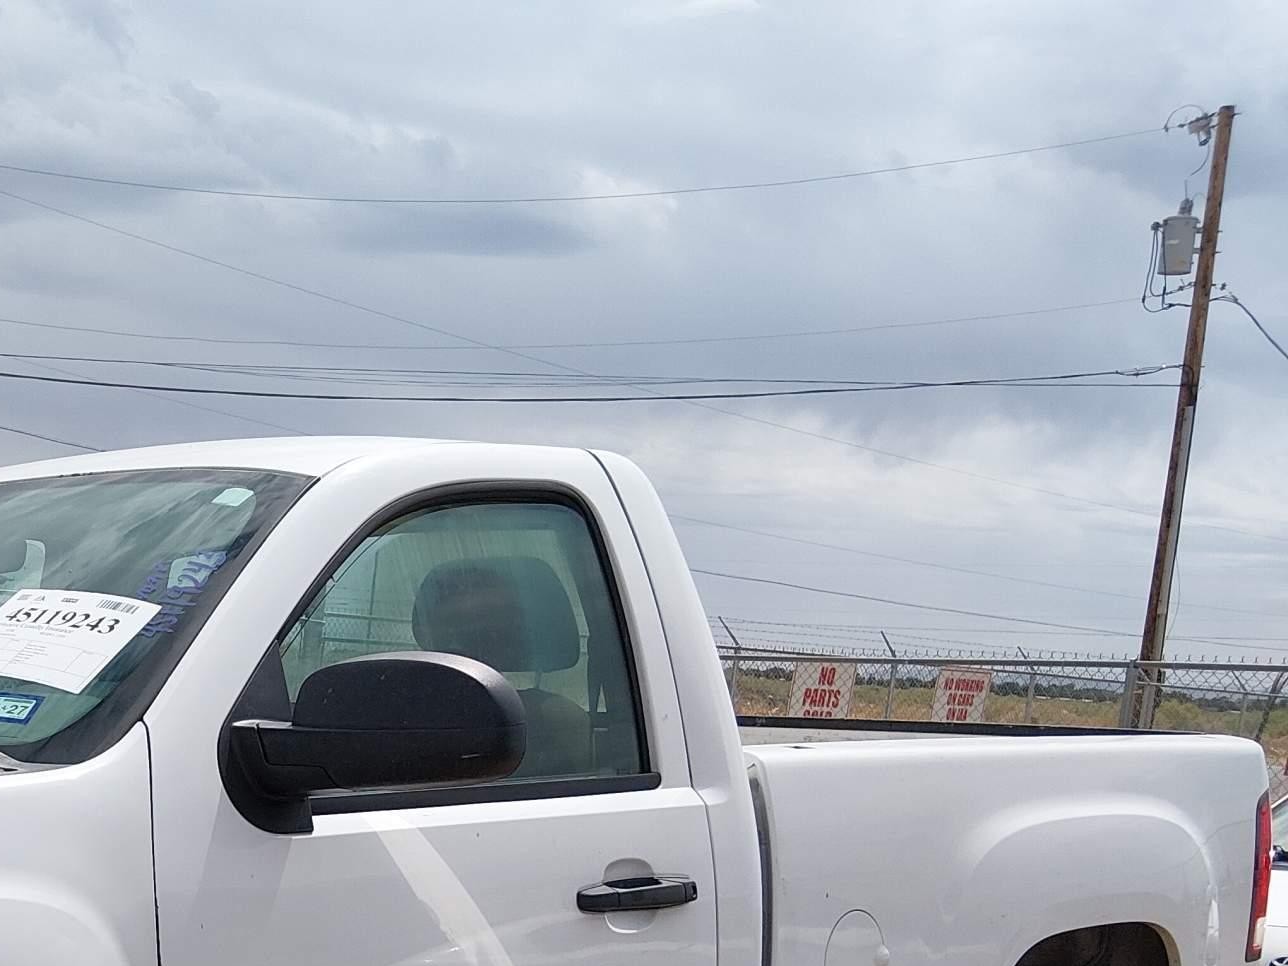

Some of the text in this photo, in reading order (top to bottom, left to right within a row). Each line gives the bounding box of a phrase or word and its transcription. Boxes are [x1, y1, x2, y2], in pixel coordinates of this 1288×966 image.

[5, 607, 121, 635] 45119243
[818, 666, 836, 686] NO
[943, 678, 954, 690] NO
[802, 688, 841, 708] PARTS
